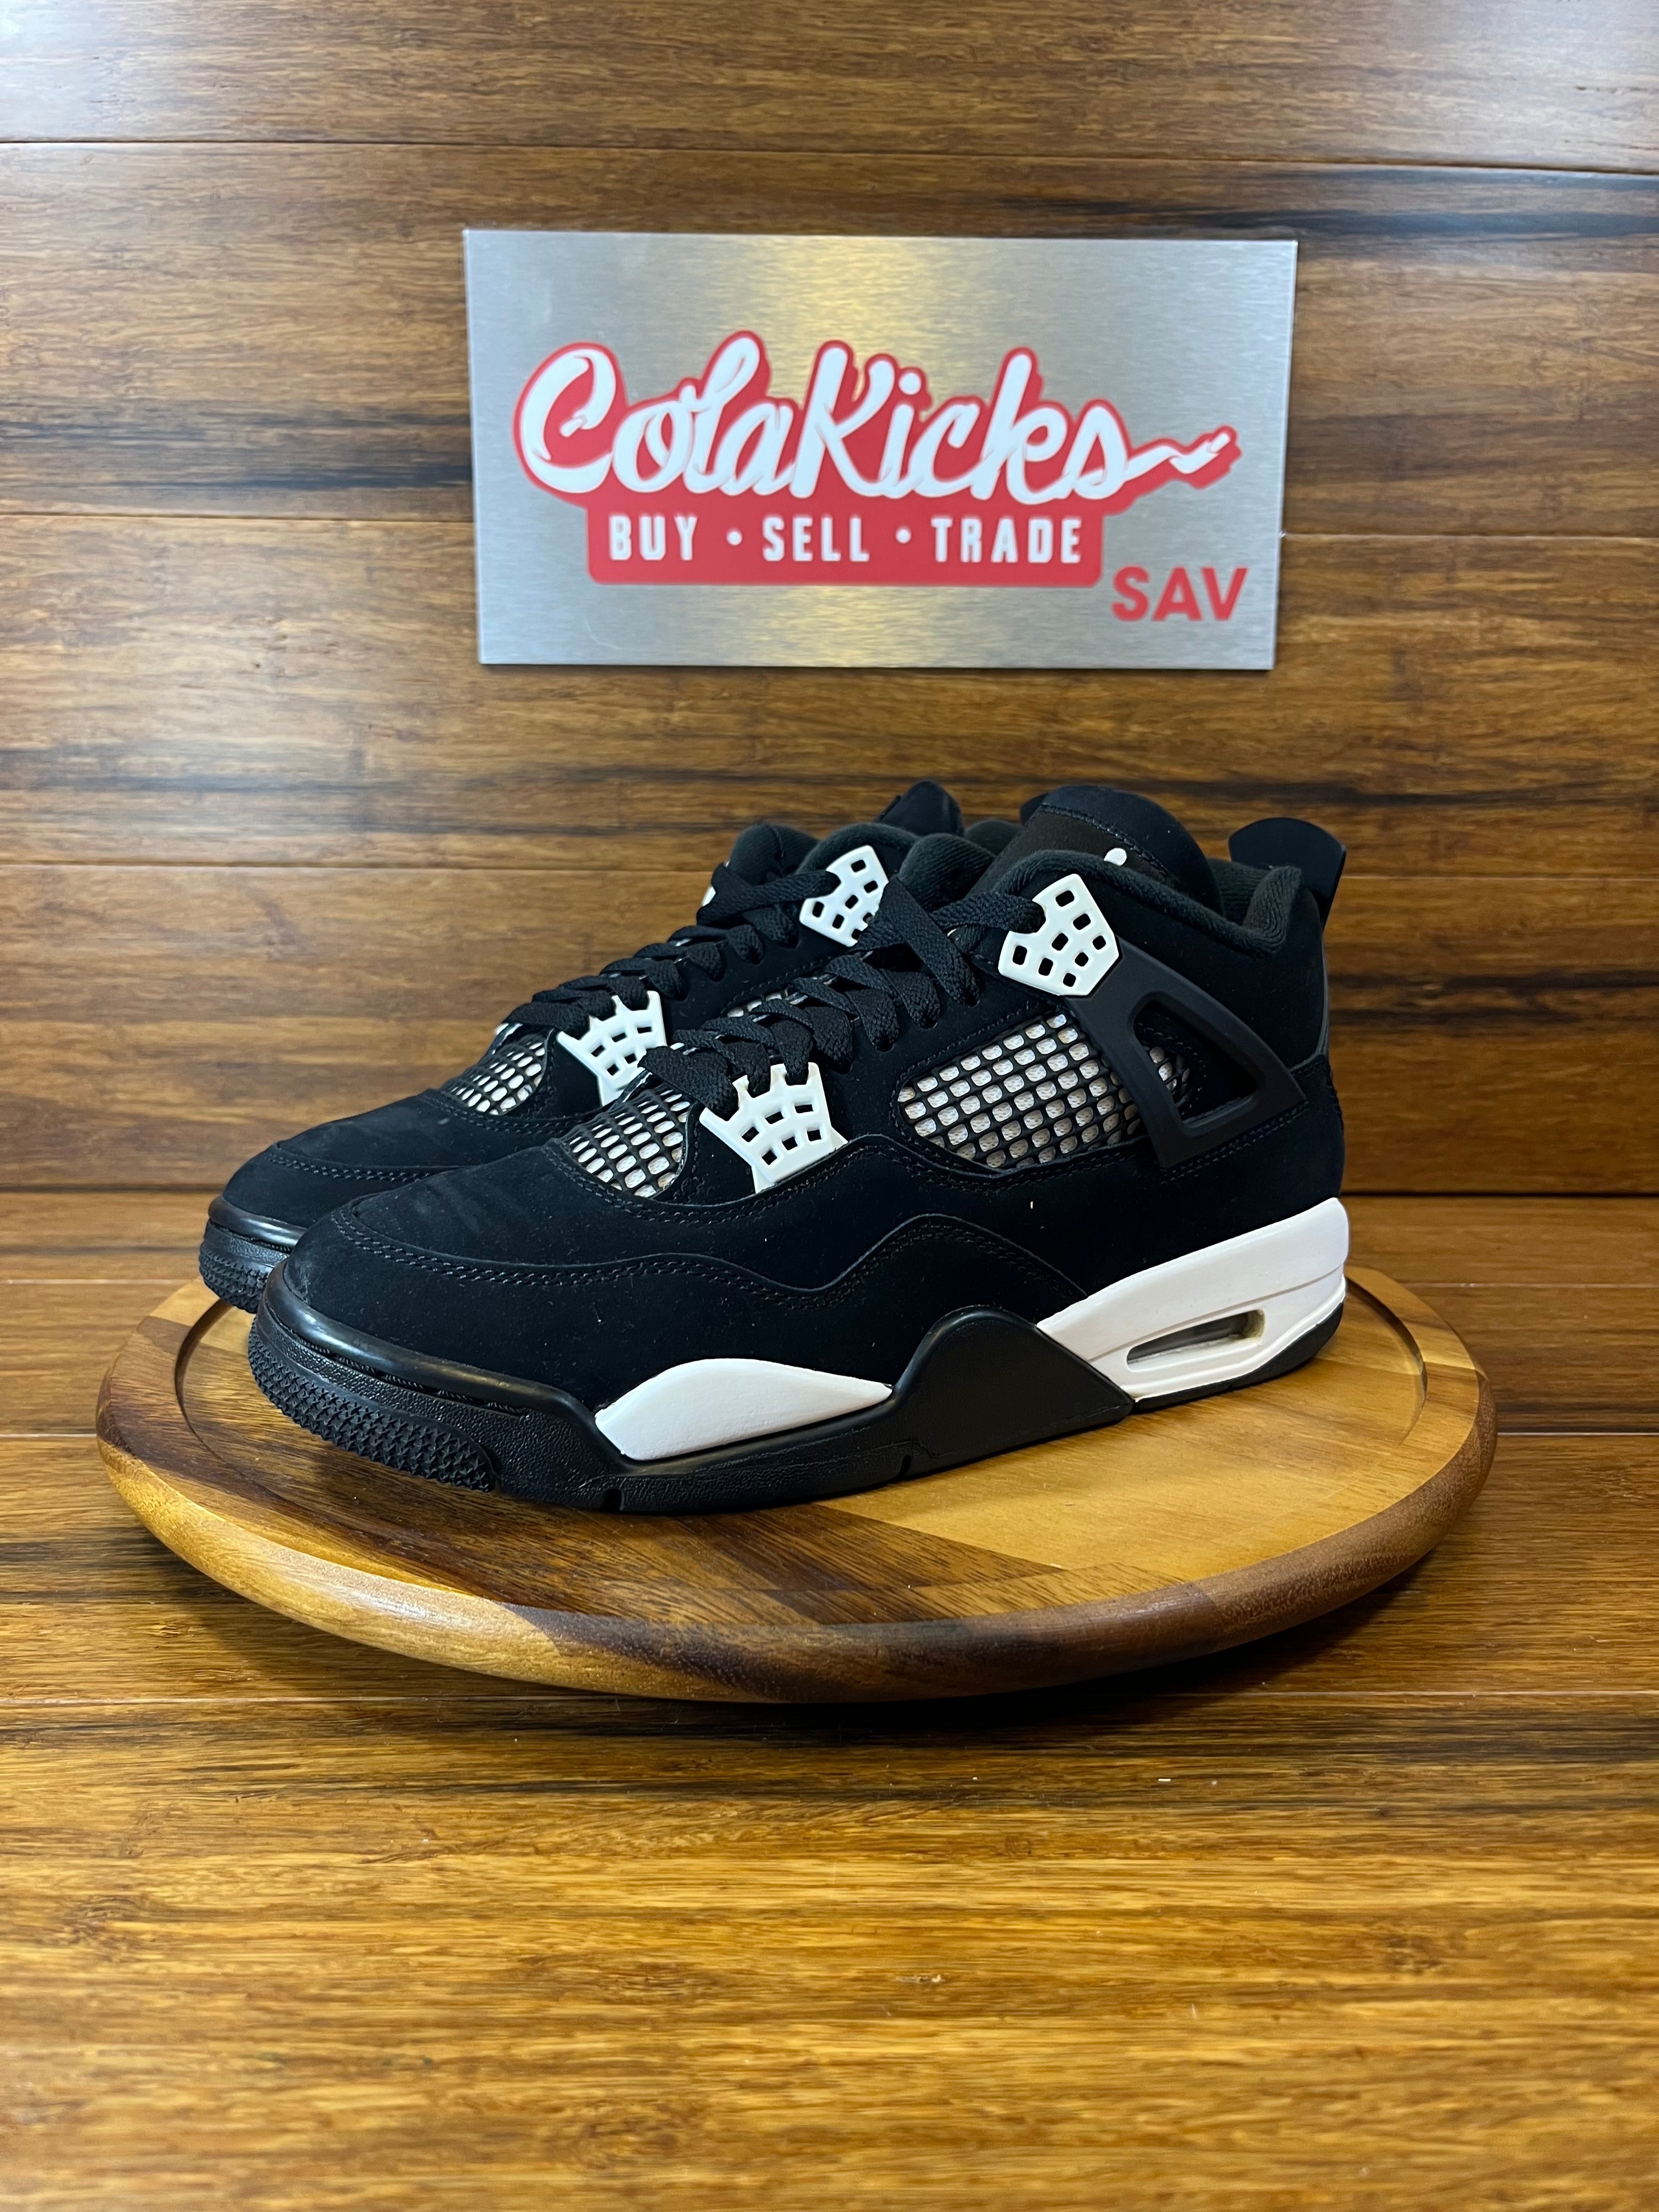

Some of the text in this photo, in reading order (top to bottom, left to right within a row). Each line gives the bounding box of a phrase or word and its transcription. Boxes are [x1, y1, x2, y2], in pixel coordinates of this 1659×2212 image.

[522, 336, 1232, 503] ColaKicks
[608, 515, 1083, 564] BUY SELL TRADE
[1111, 566, 1249, 622] SAV
